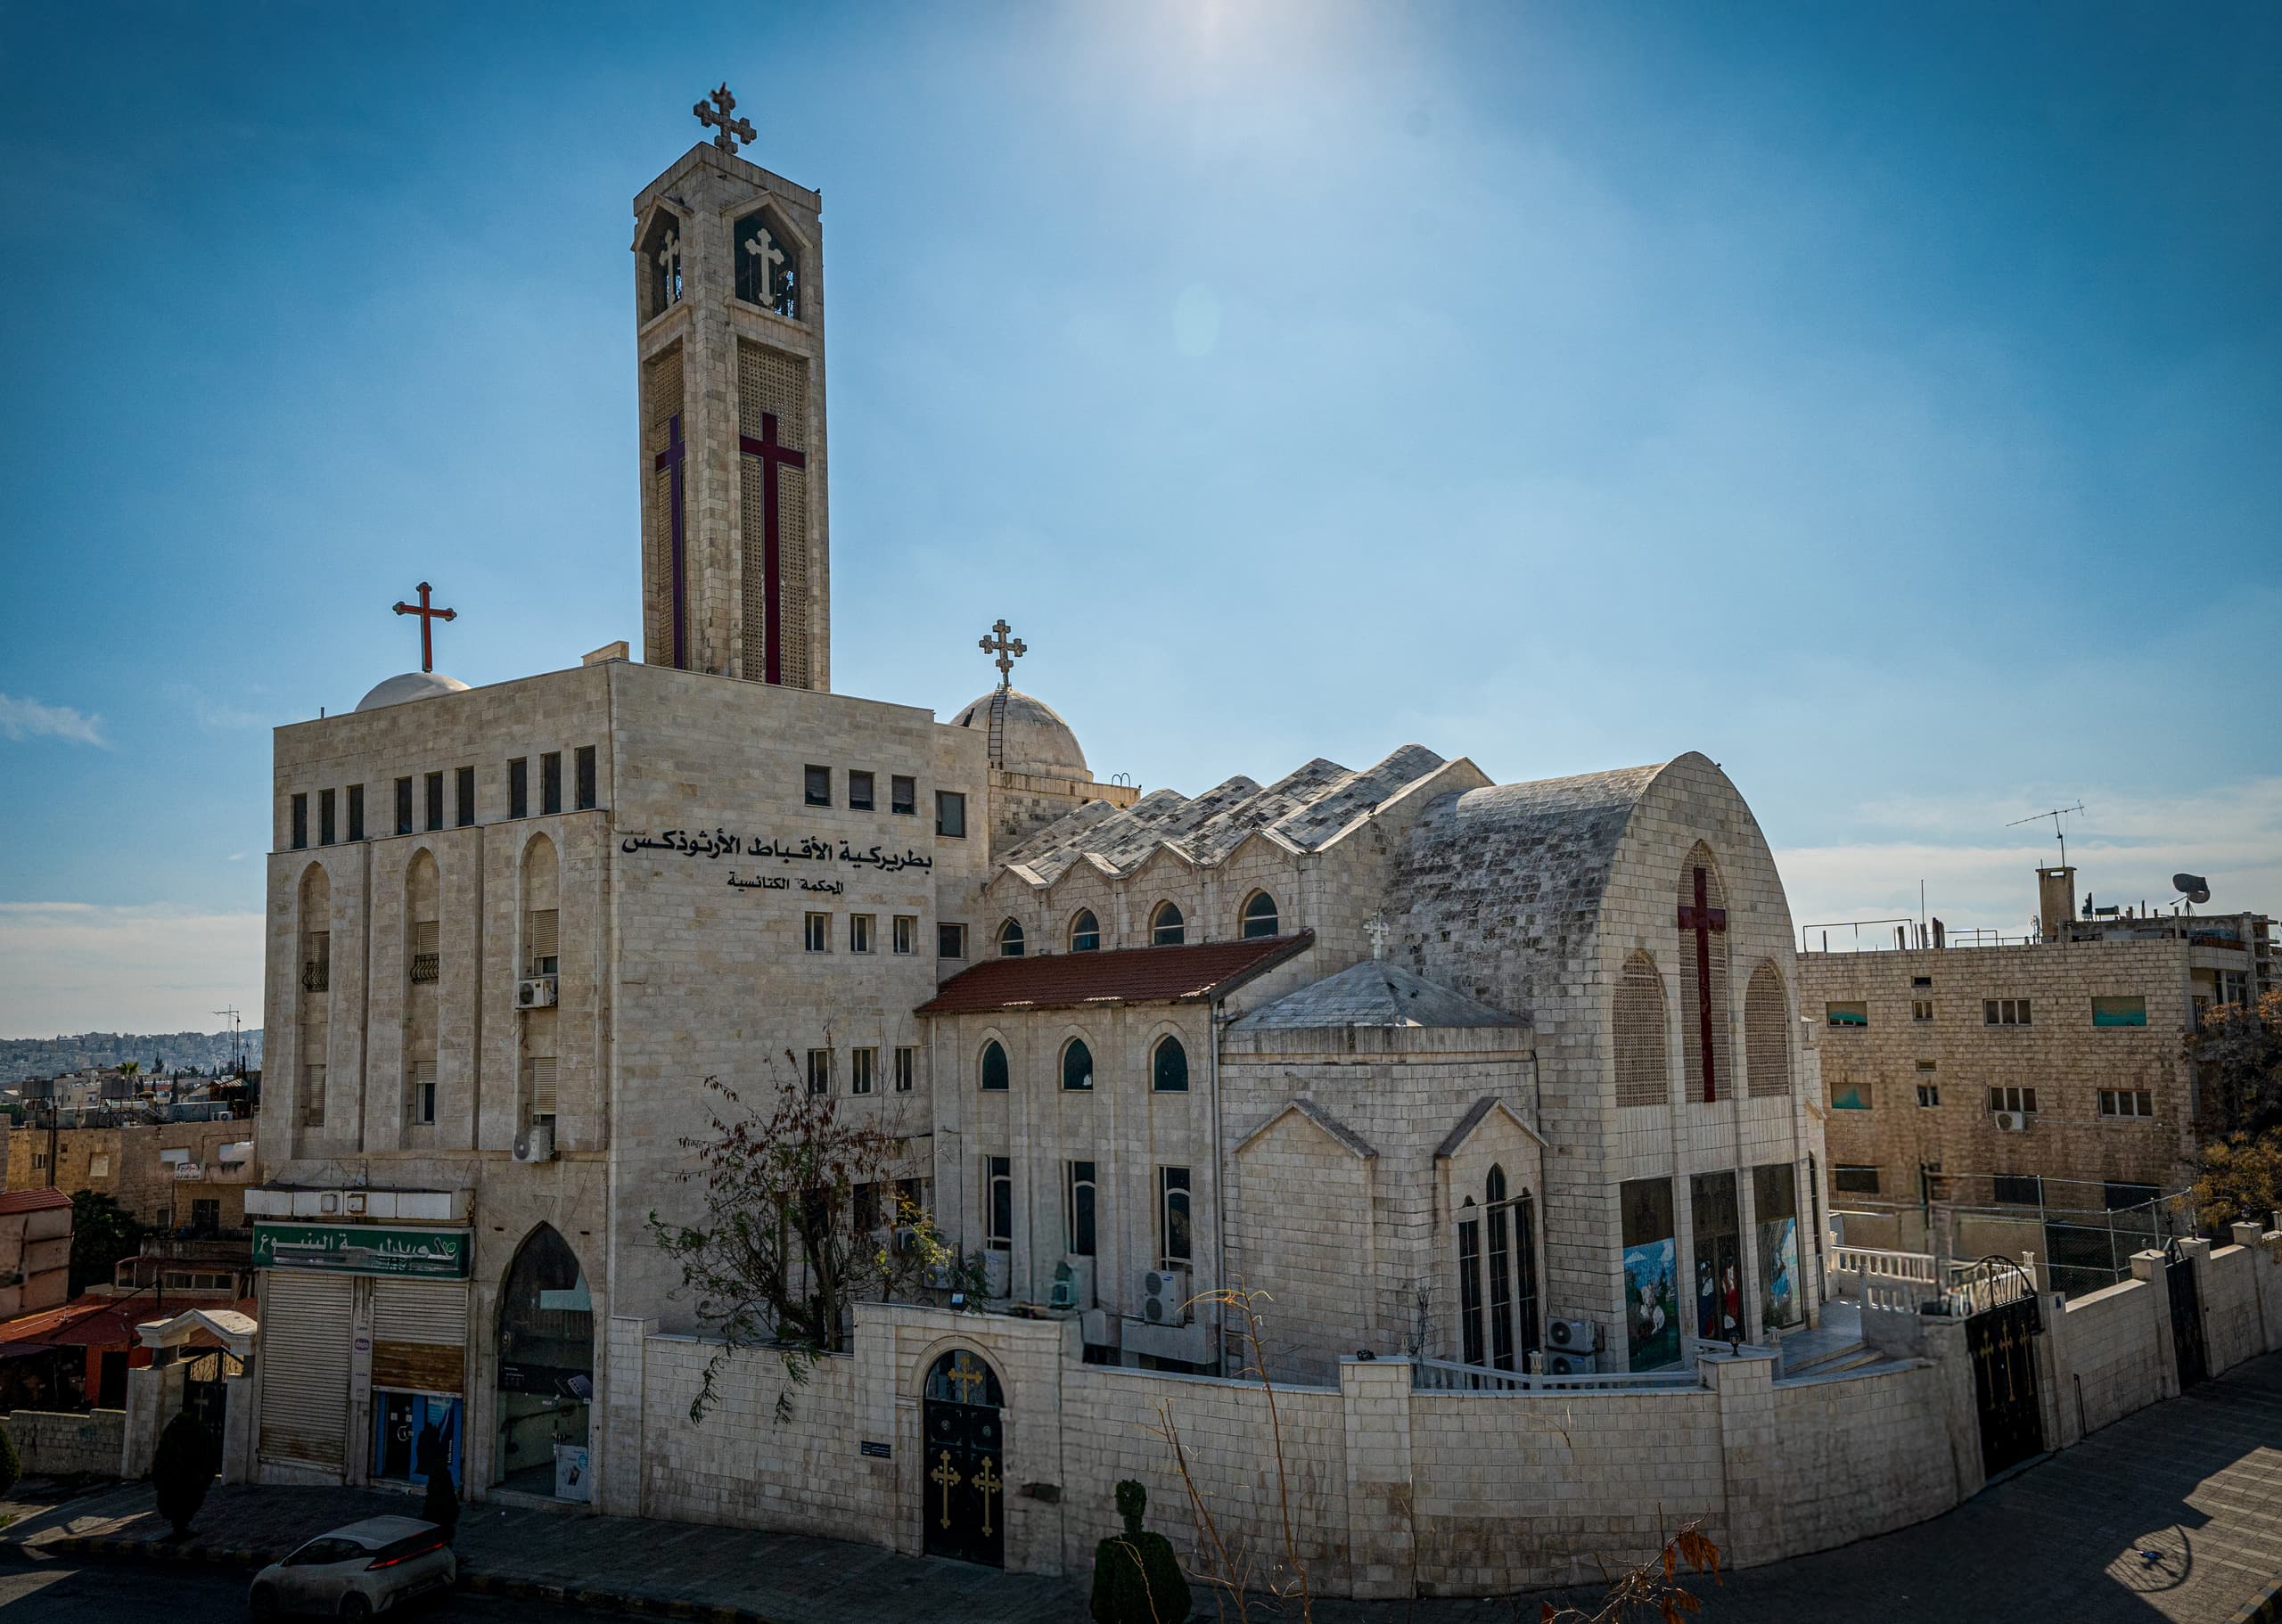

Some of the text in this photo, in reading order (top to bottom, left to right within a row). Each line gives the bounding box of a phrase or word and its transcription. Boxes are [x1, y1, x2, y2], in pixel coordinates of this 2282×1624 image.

[622, 828, 933, 875] بطريركية الأقباط الأرثوذكس
